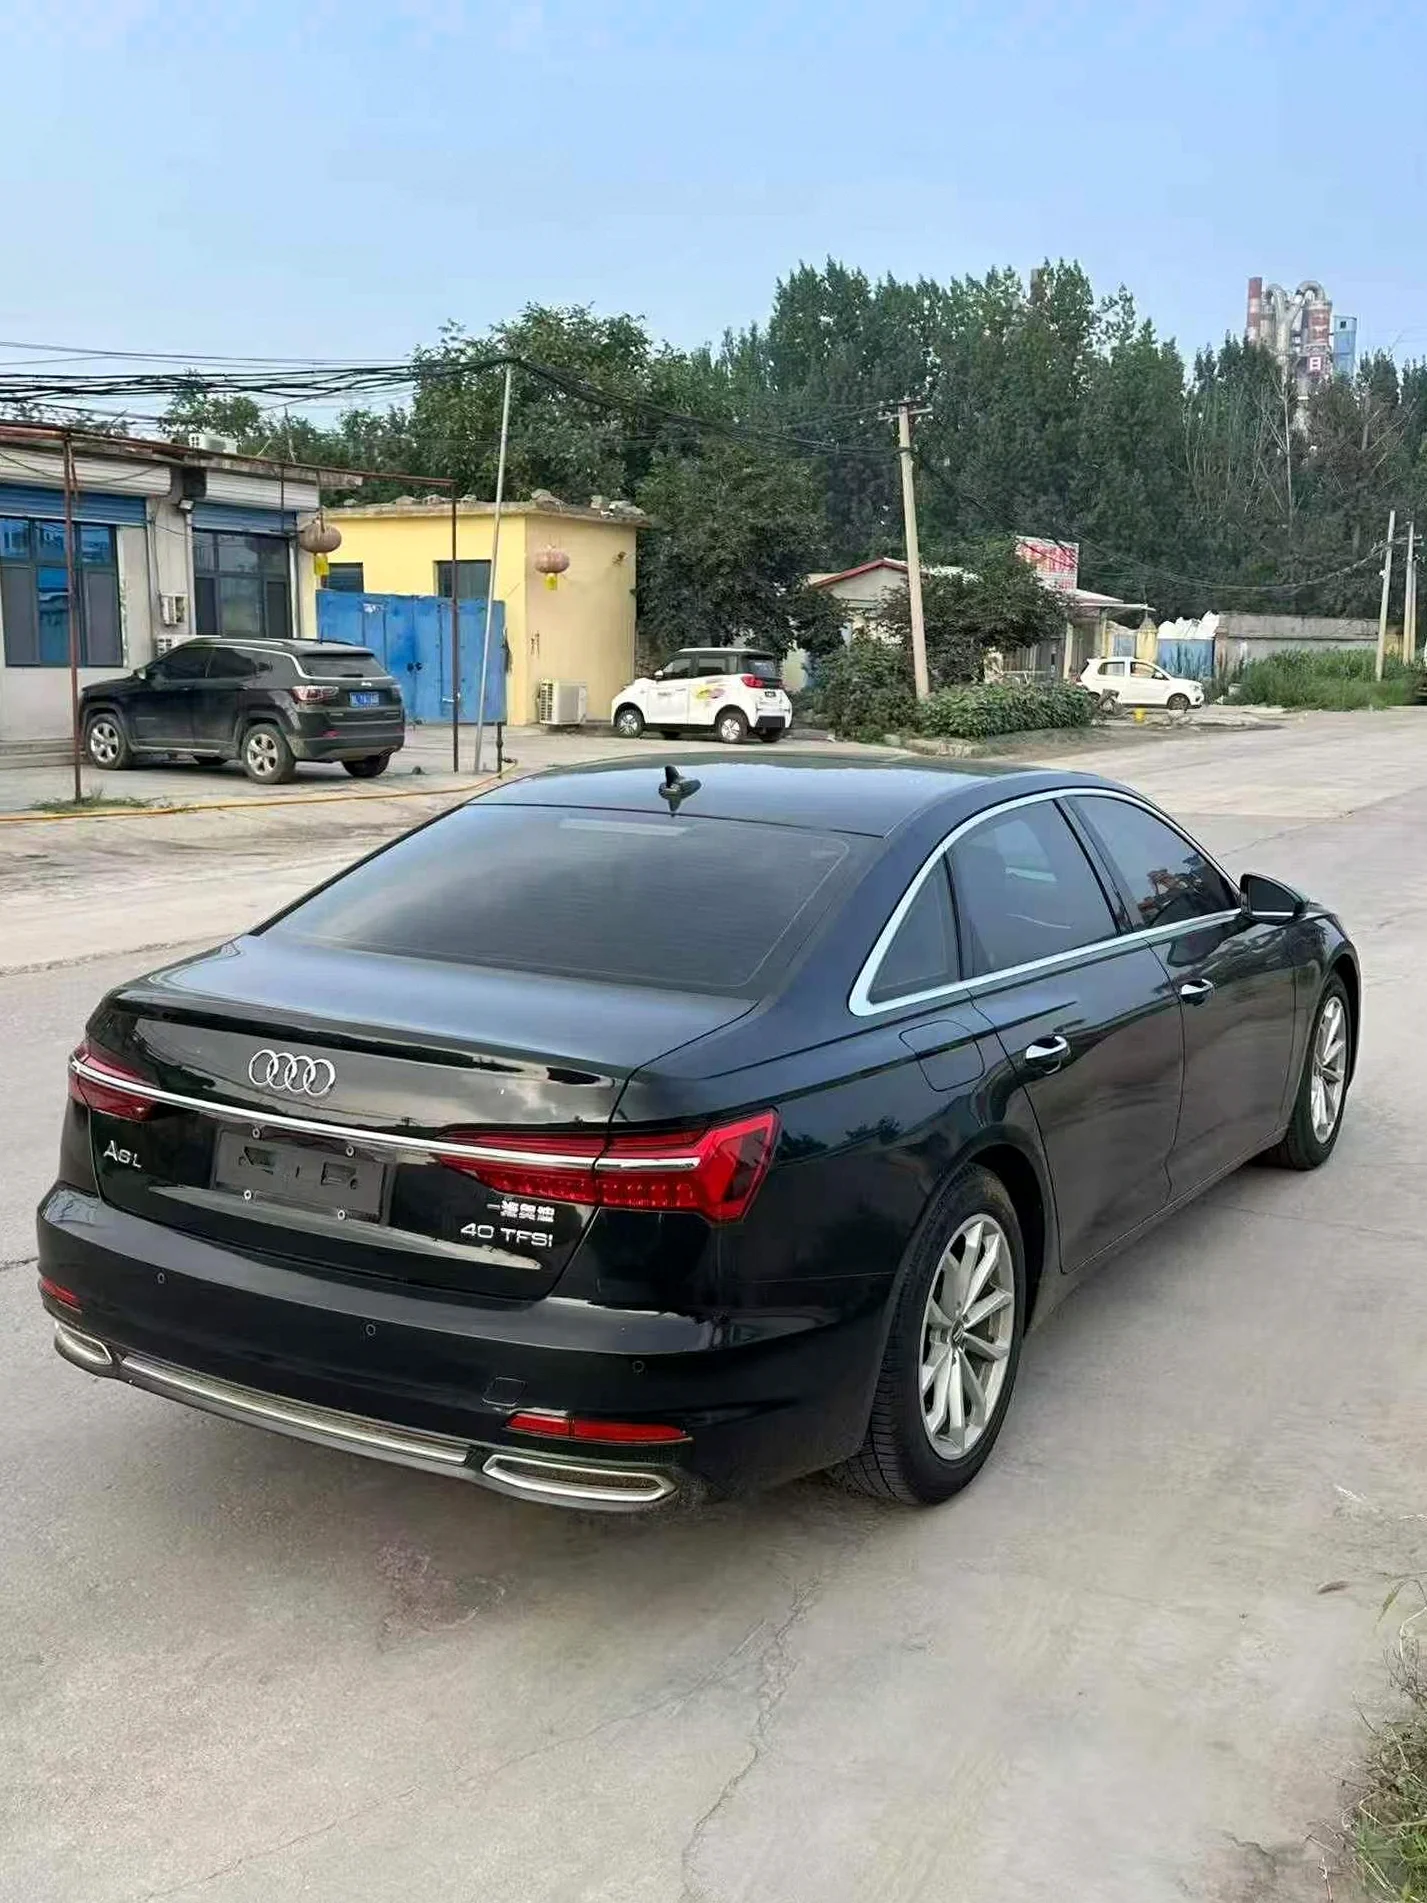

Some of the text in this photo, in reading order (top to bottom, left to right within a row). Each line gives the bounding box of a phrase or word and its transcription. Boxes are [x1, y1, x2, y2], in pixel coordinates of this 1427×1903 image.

[103, 1140, 142, 1168] A6L
[460, 1222, 553, 1247] 40 TFSI
